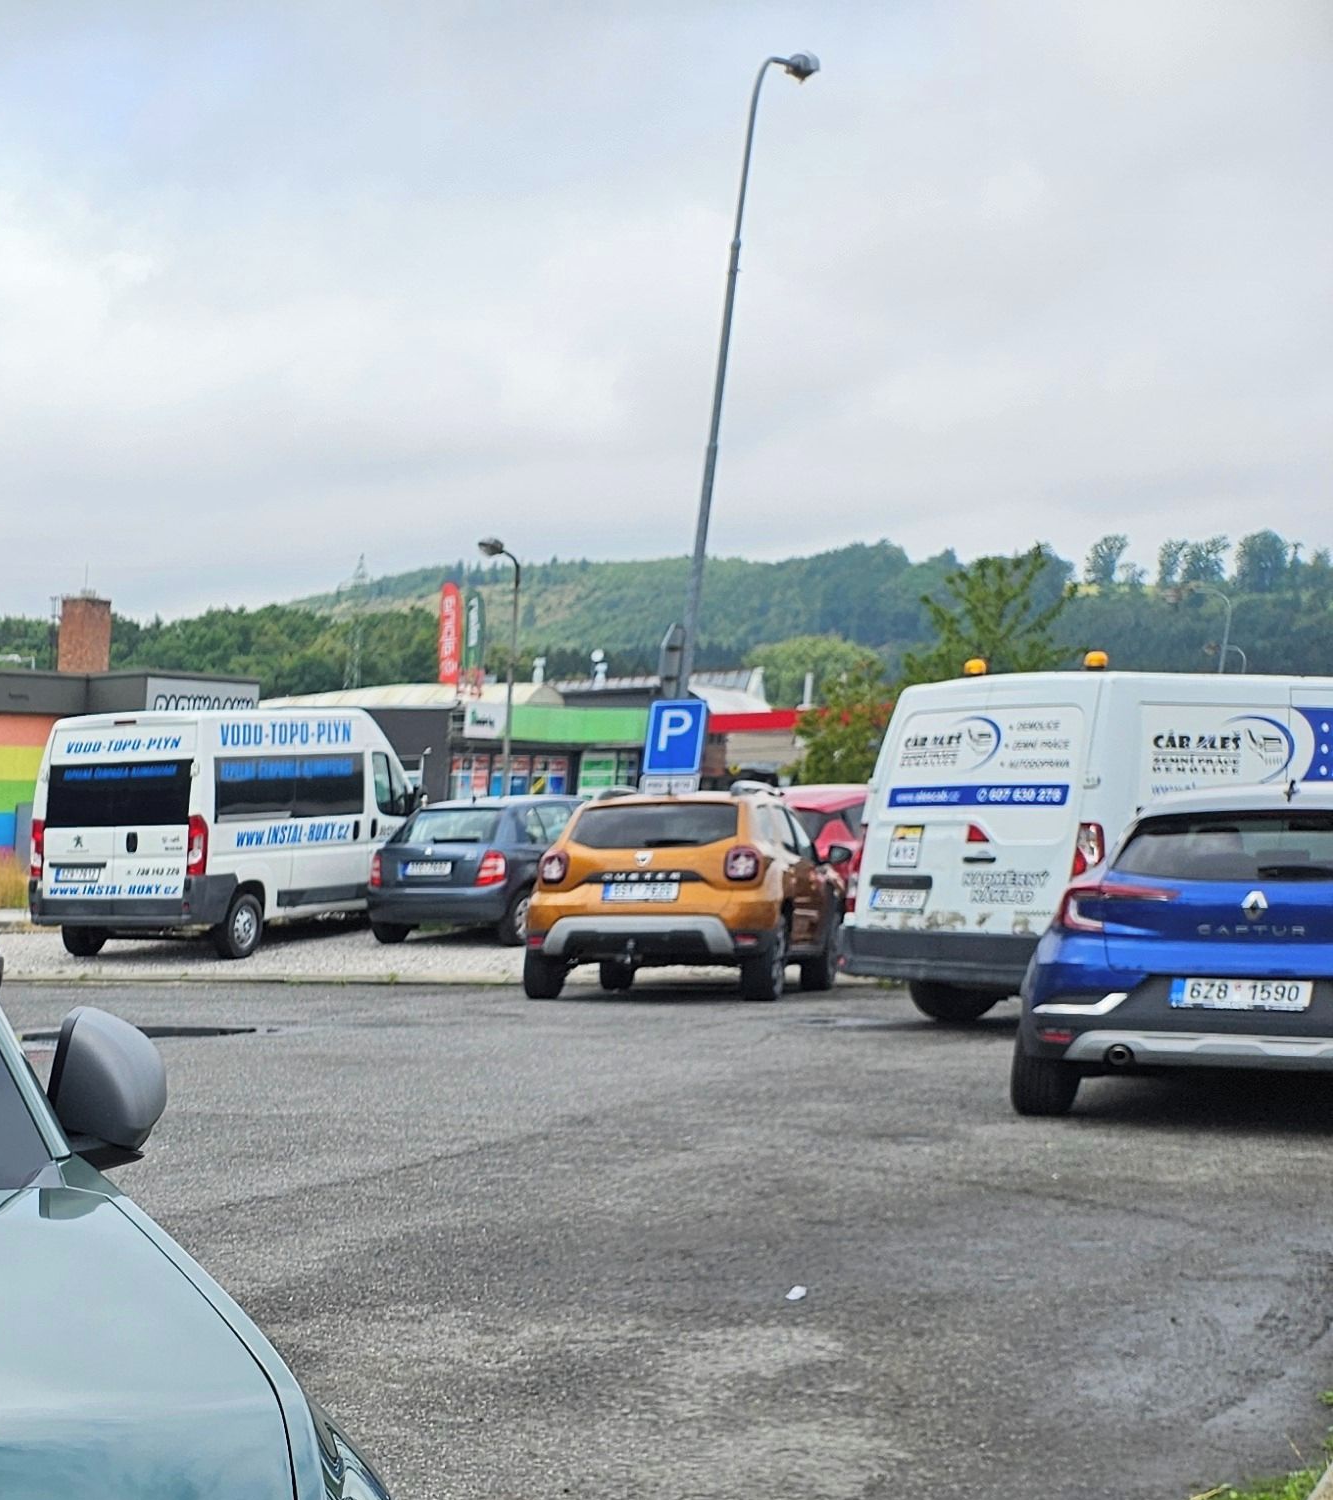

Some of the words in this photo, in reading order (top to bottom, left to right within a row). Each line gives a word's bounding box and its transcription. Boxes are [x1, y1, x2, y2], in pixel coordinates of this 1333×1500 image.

[657, 708, 693, 752] P
[1196, 923, 1306, 937] CAPTUR
[1189, 981, 1229, 1000] 6Z8
[1248, 983, 1301, 1002] 1590
